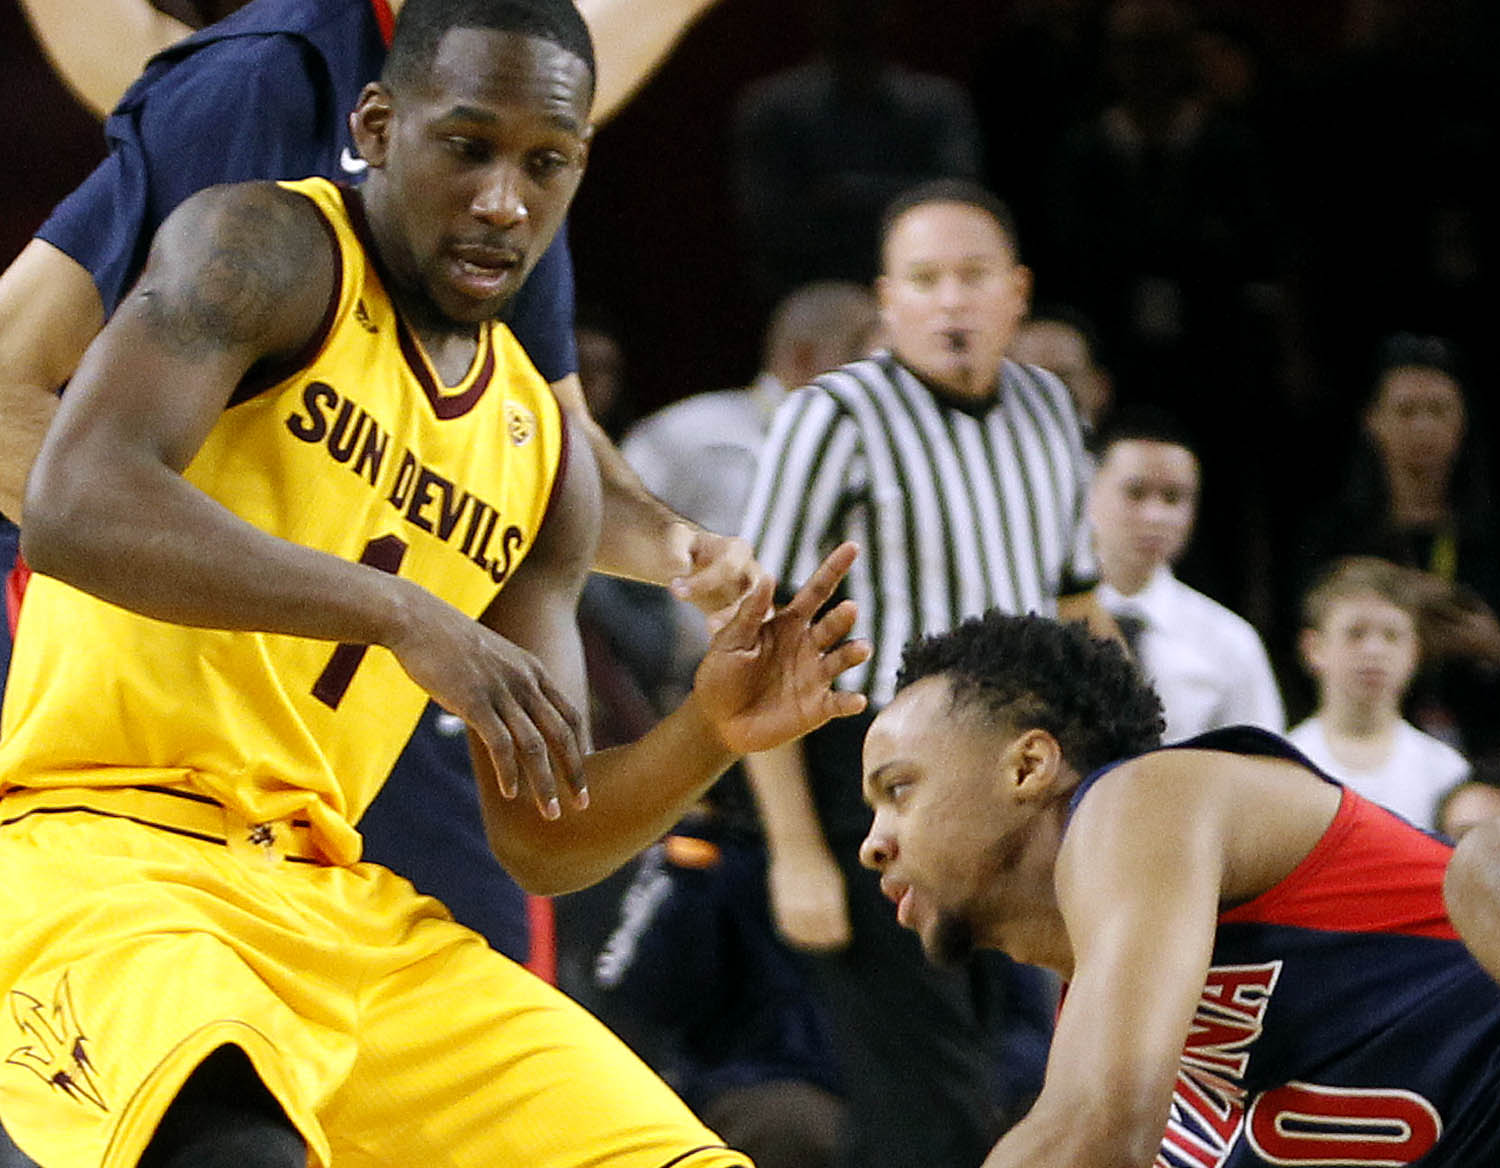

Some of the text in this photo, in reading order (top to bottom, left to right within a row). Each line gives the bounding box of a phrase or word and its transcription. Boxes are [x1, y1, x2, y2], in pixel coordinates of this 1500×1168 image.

[283, 381, 523, 584] SUN DEVILS
[1245, 1080, 1443, 1167] 0
